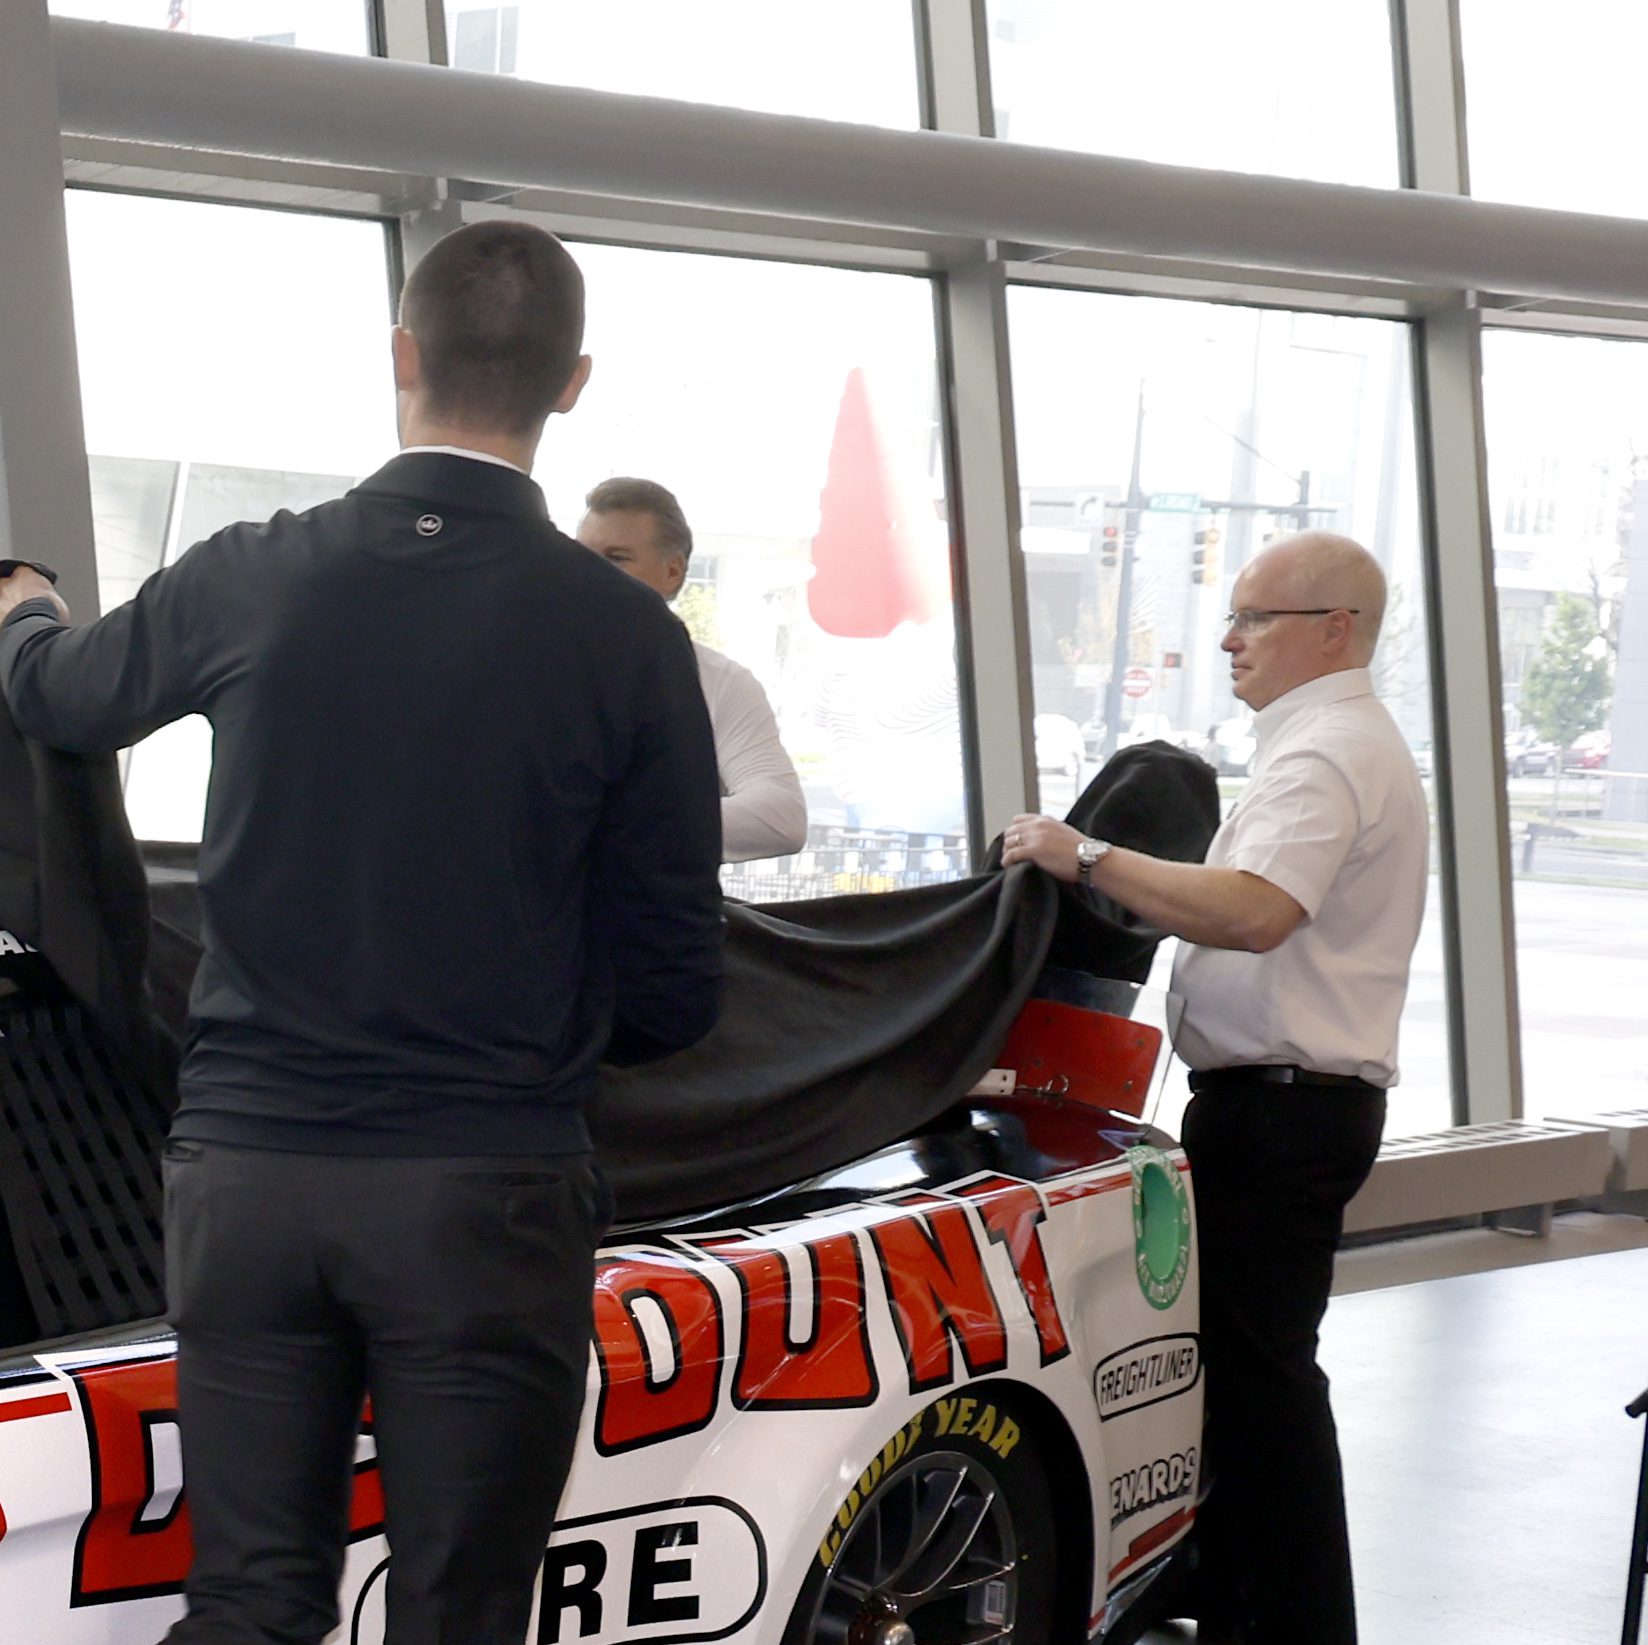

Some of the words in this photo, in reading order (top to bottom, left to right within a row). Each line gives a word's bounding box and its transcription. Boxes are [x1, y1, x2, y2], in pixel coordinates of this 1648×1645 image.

[70, 1177, 1071, 1608] DOUNT
[1100, 1346, 1195, 1406] FREIGHTLINER
[933, 1397, 1021, 1459] YEAR
[1109, 1447, 1197, 1515] ENARDS
